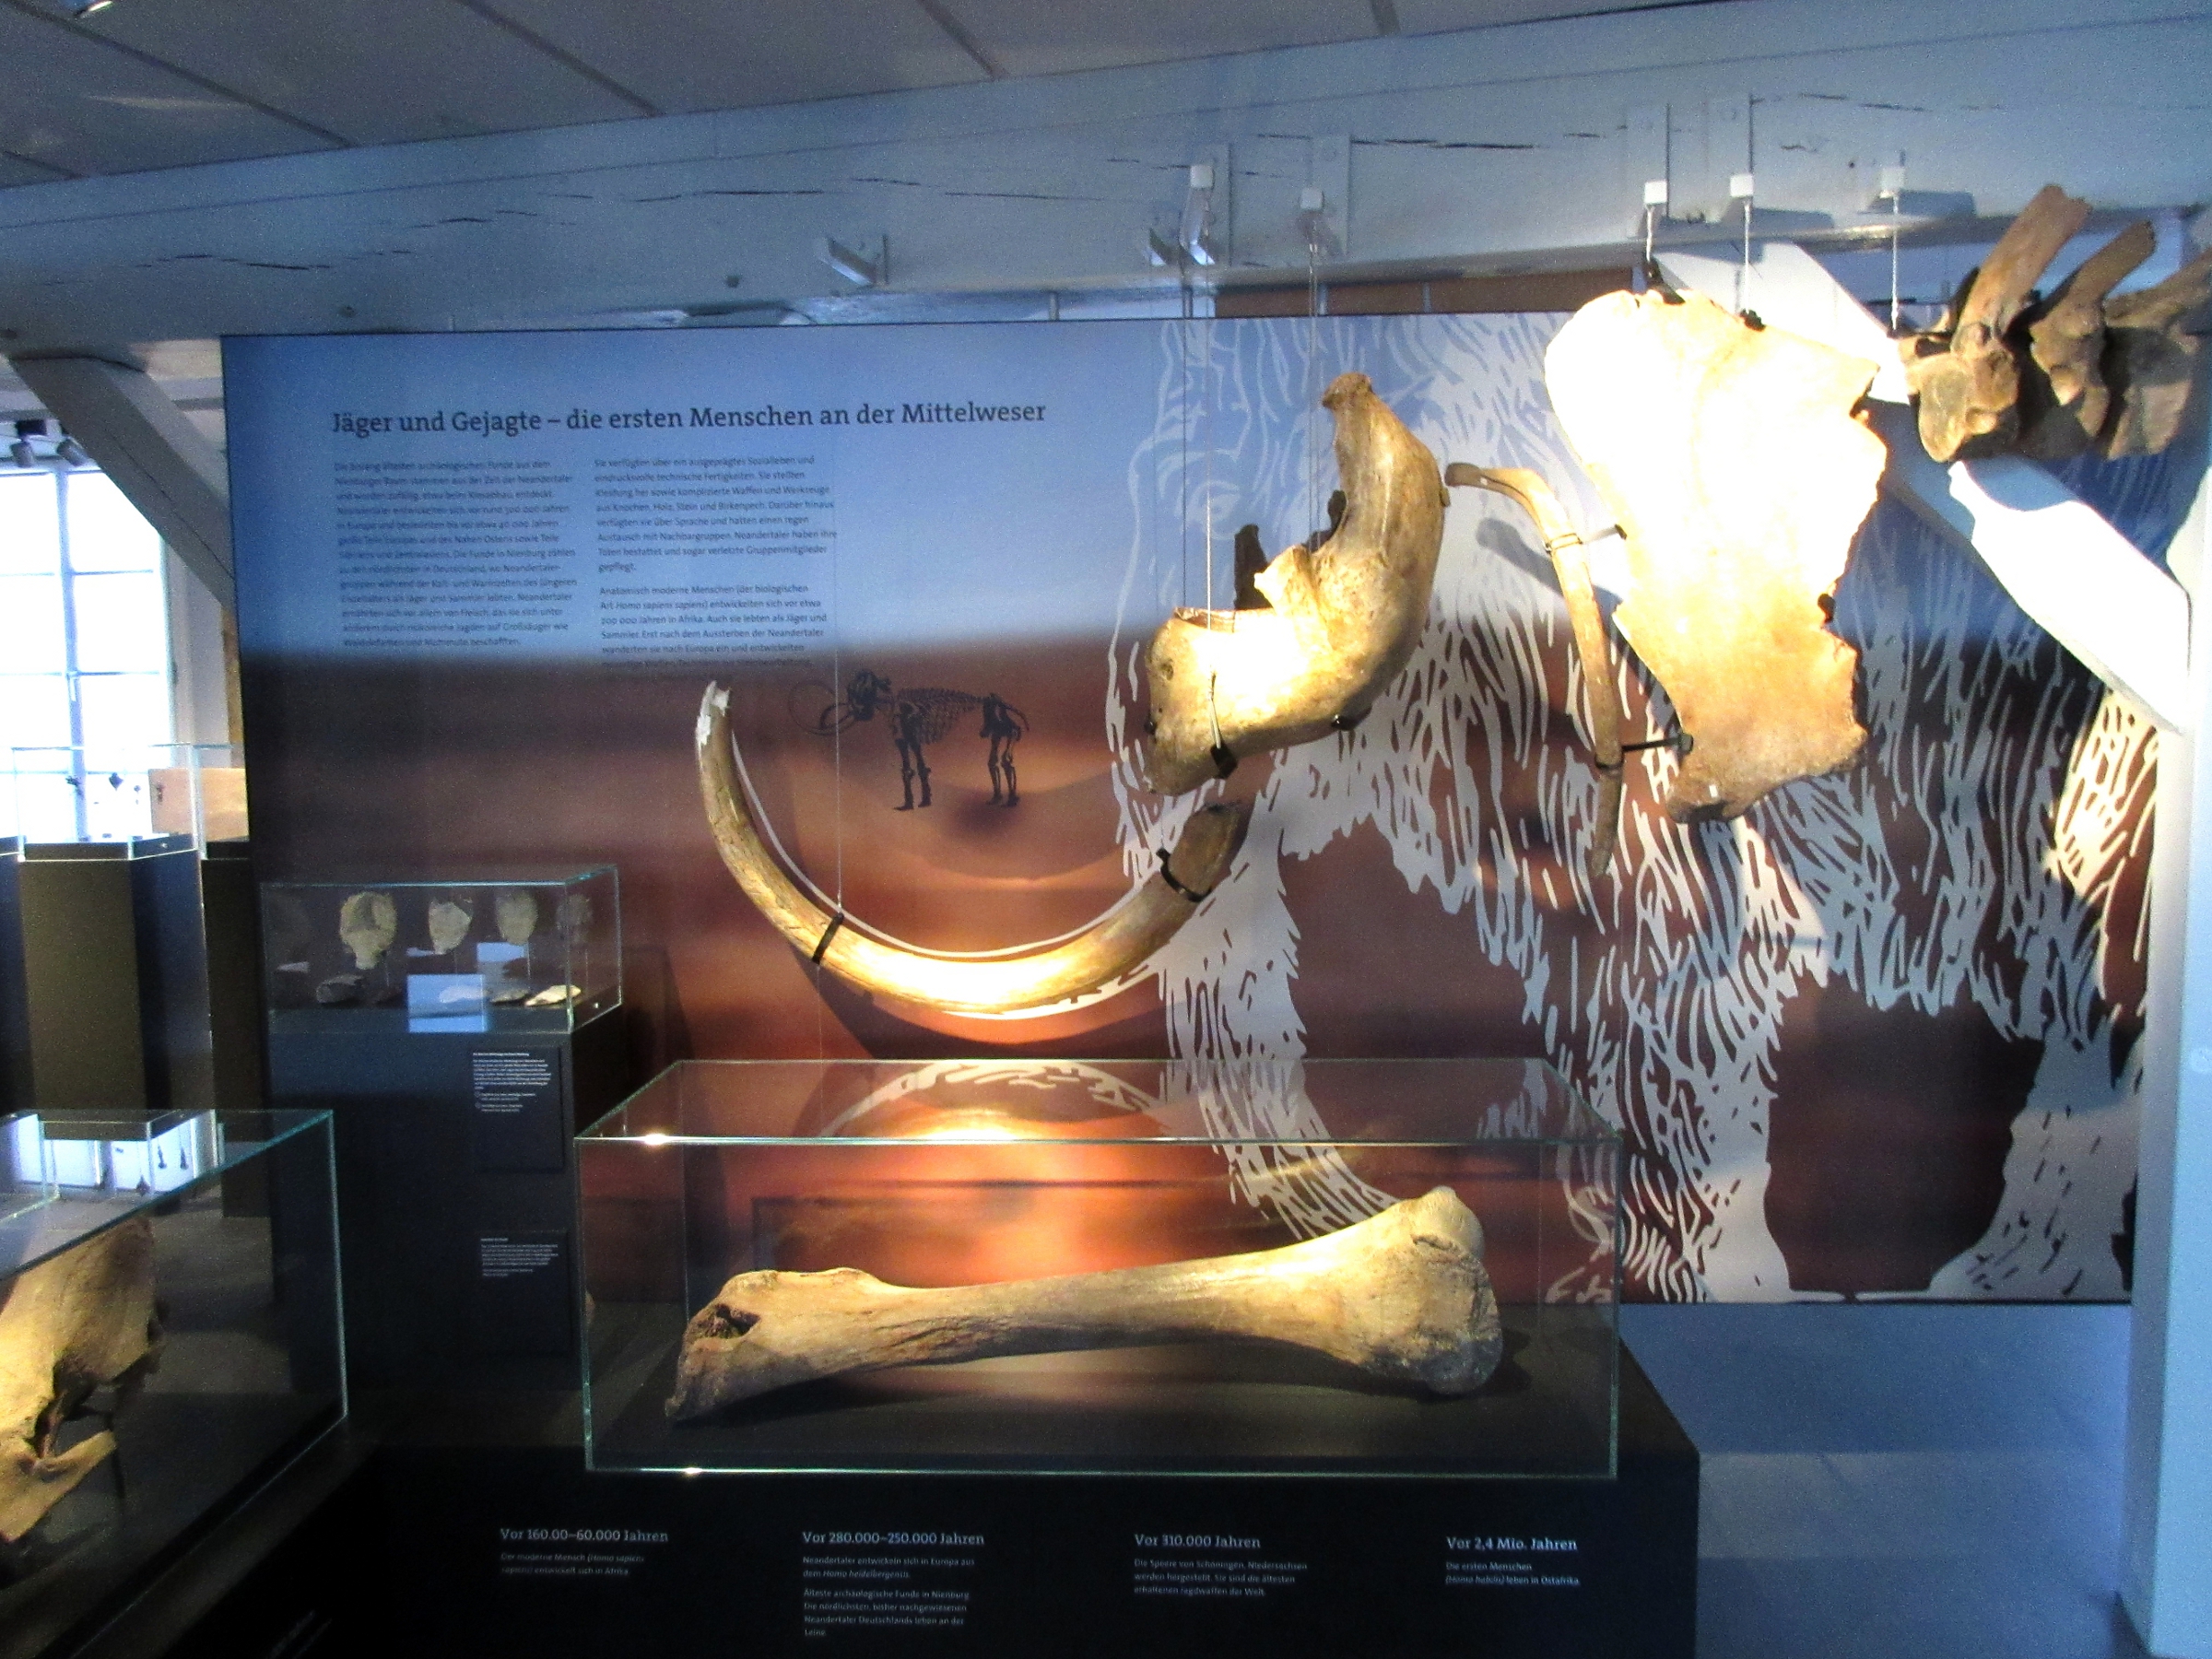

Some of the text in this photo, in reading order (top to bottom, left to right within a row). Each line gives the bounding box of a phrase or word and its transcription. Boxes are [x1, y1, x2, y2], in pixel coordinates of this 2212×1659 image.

[332, 409, 393, 435] Jäger
[399, 408, 443, 429] und
[452, 407, 540, 433] Gejagte
[566, 406, 601, 428] die
[609, 406, 681, 427] ersten
[690, 405, 811, 425] Menschen
[820, 408, 848, 424] an
[856, 403, 896, 423] der
[902, 401, 1048, 422] Mittelweser
[500, 1527, 524, 1540] Vor
[624, 1529, 668, 1543] Jahren
[803, 1531, 826, 1545] Vor
[940, 1533, 984, 1546] Jahren
[1135, 1534, 1261, 1548] Vor 310.000 Jahren
[1446, 1537, 1577, 1552] Vor 2,4 Mio. Jahren
